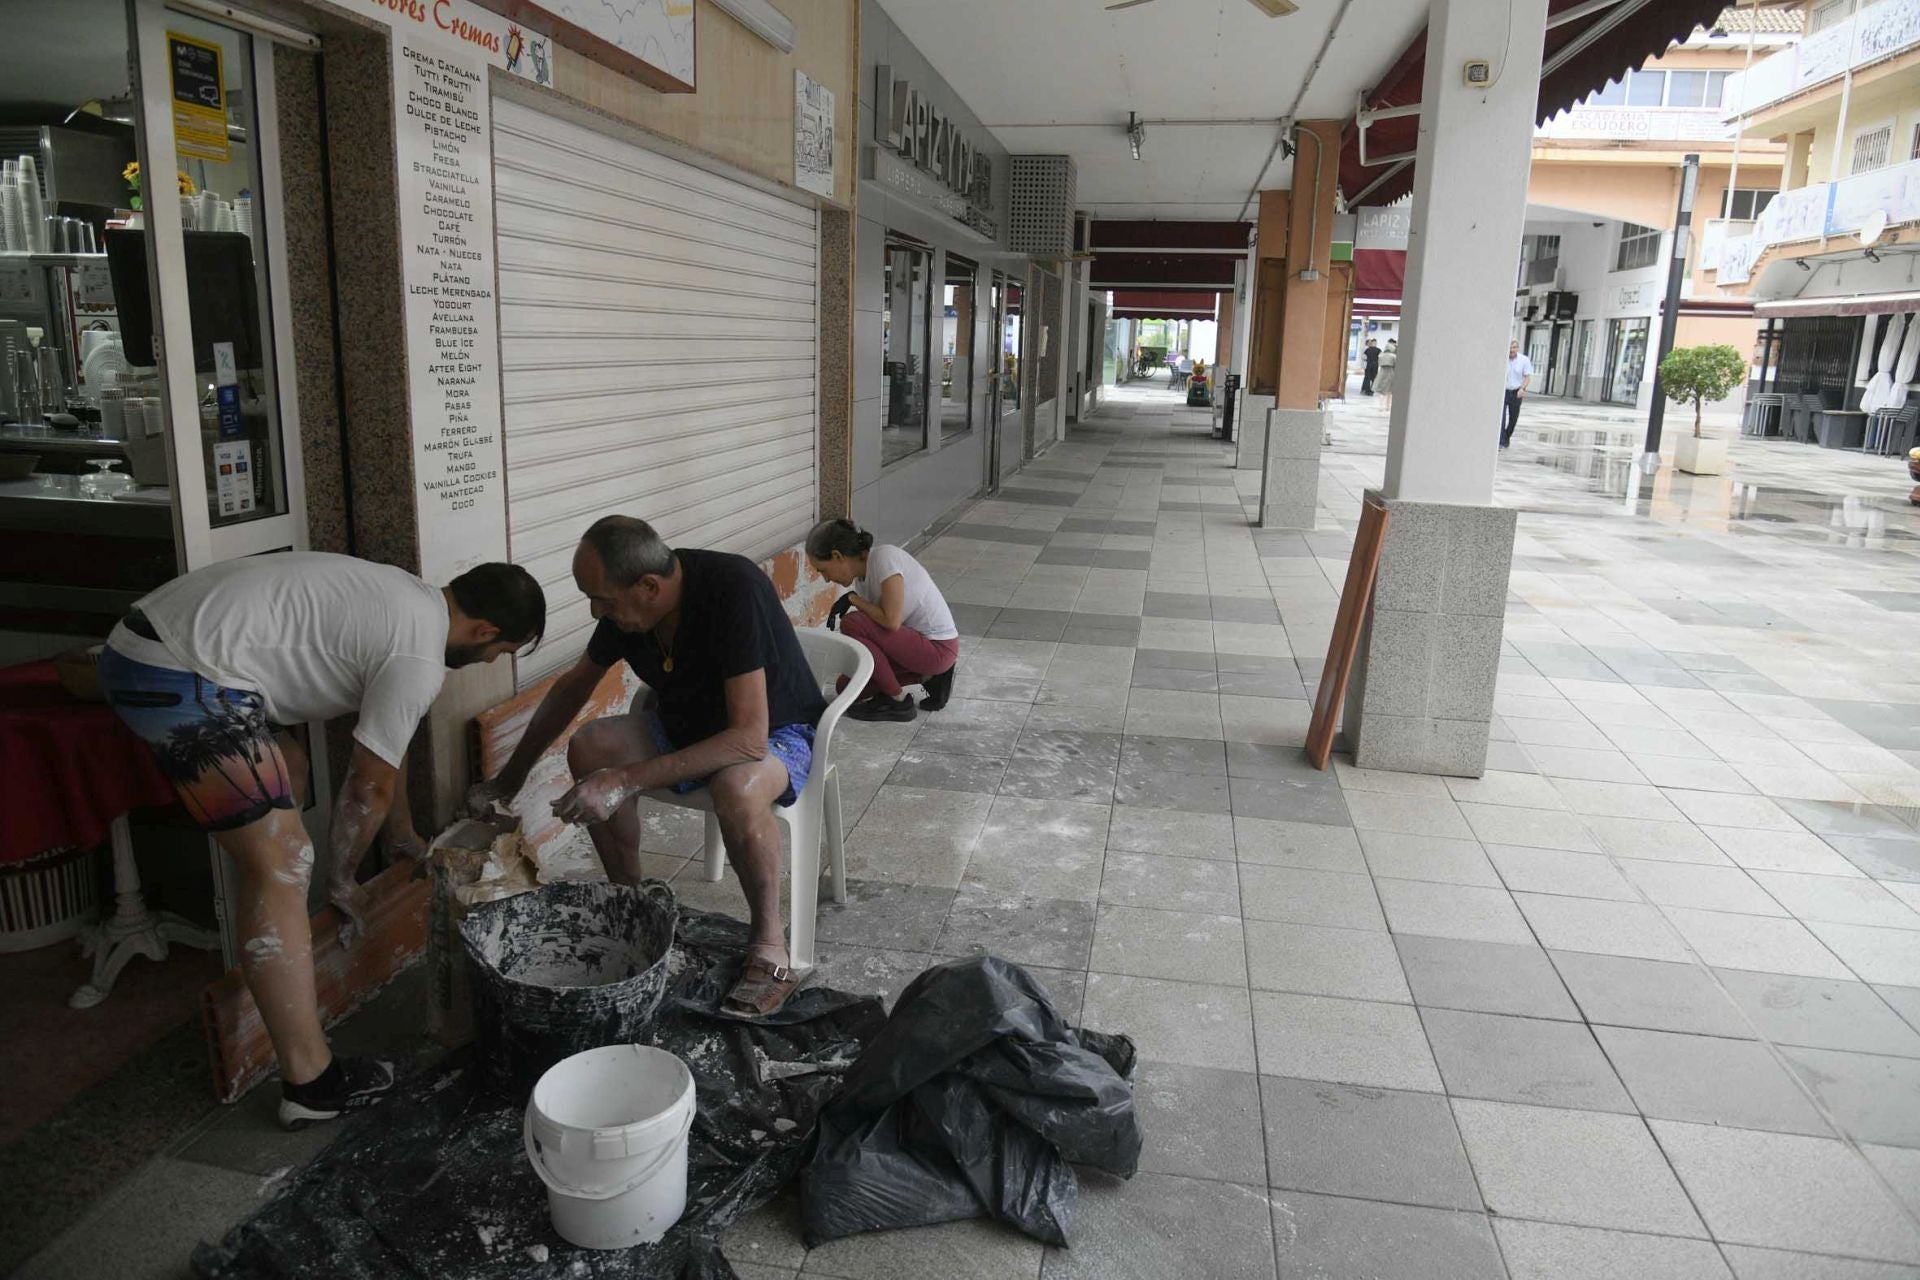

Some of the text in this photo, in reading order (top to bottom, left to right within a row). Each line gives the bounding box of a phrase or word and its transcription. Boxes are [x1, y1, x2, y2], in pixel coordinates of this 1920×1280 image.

[372, 0, 499, 53] ores Cremas
[403, 46, 481, 82] CREMA CATALANA
[414, 65, 472, 92] TUTTI FRUTTI
[424, 80, 464, 103] TIRAMISÚ
[409, 91, 479, 120] CHOCO BLANCO
[407, 105, 436, 122] DULCE
[455, 119, 481, 134] LECHE
[875, 64, 944, 176] LAPIZ
[1576, 111, 1646, 121] ACADEMIA
[1571, 120, 1648, 131] ESCUDERO
[424, 124, 466, 143] PISTACHO
[433, 139, 460, 154] LIMÓN
[433, 153, 460, 167] FRESA
[413, 162, 479, 184] STRACCIATELLA
[429, 180, 466, 194] VAINILLA
[425, 192, 470, 208] CARAMELO
[423, 205, 473, 221] CHOCOLATE
[439, 220, 460, 232] CAFÉ
[1363, 212, 1401, 228] LAPIZ
[433, 233, 466, 246] TURRÓN
[417, 246, 440, 256] NATA
[449, 249, 482, 260] NUECES
[440, 261, 462, 271] NATA
[433, 272, 471, 285] PLÁTANO
[410, 285, 491, 298] LECHE MERENGADA
[434, 300, 471, 310] YOGOURT
[432, 313, 474, 322] AVELLANA
[429, 325, 478, 335] FRAMBUESA
[436, 338, 475, 348] BLUE ICE
[441, 349, 470, 360] MELÓN
[429, 363, 482, 373] AFTER EIGHT
[438, 377, 475, 385] NARANJA
[446, 389, 469, 398] MORA
[445, 402, 471, 411] PASAS
[449, 412, 469, 423] PIÑA
[441, 426, 477, 437] FERRERO
[448, 451, 473, 460] TRUFA
[447, 463, 476, 473] MANGO
[424, 471, 496, 490] VAINILLA COOKIES
[452, 500, 474, 510] COCO
